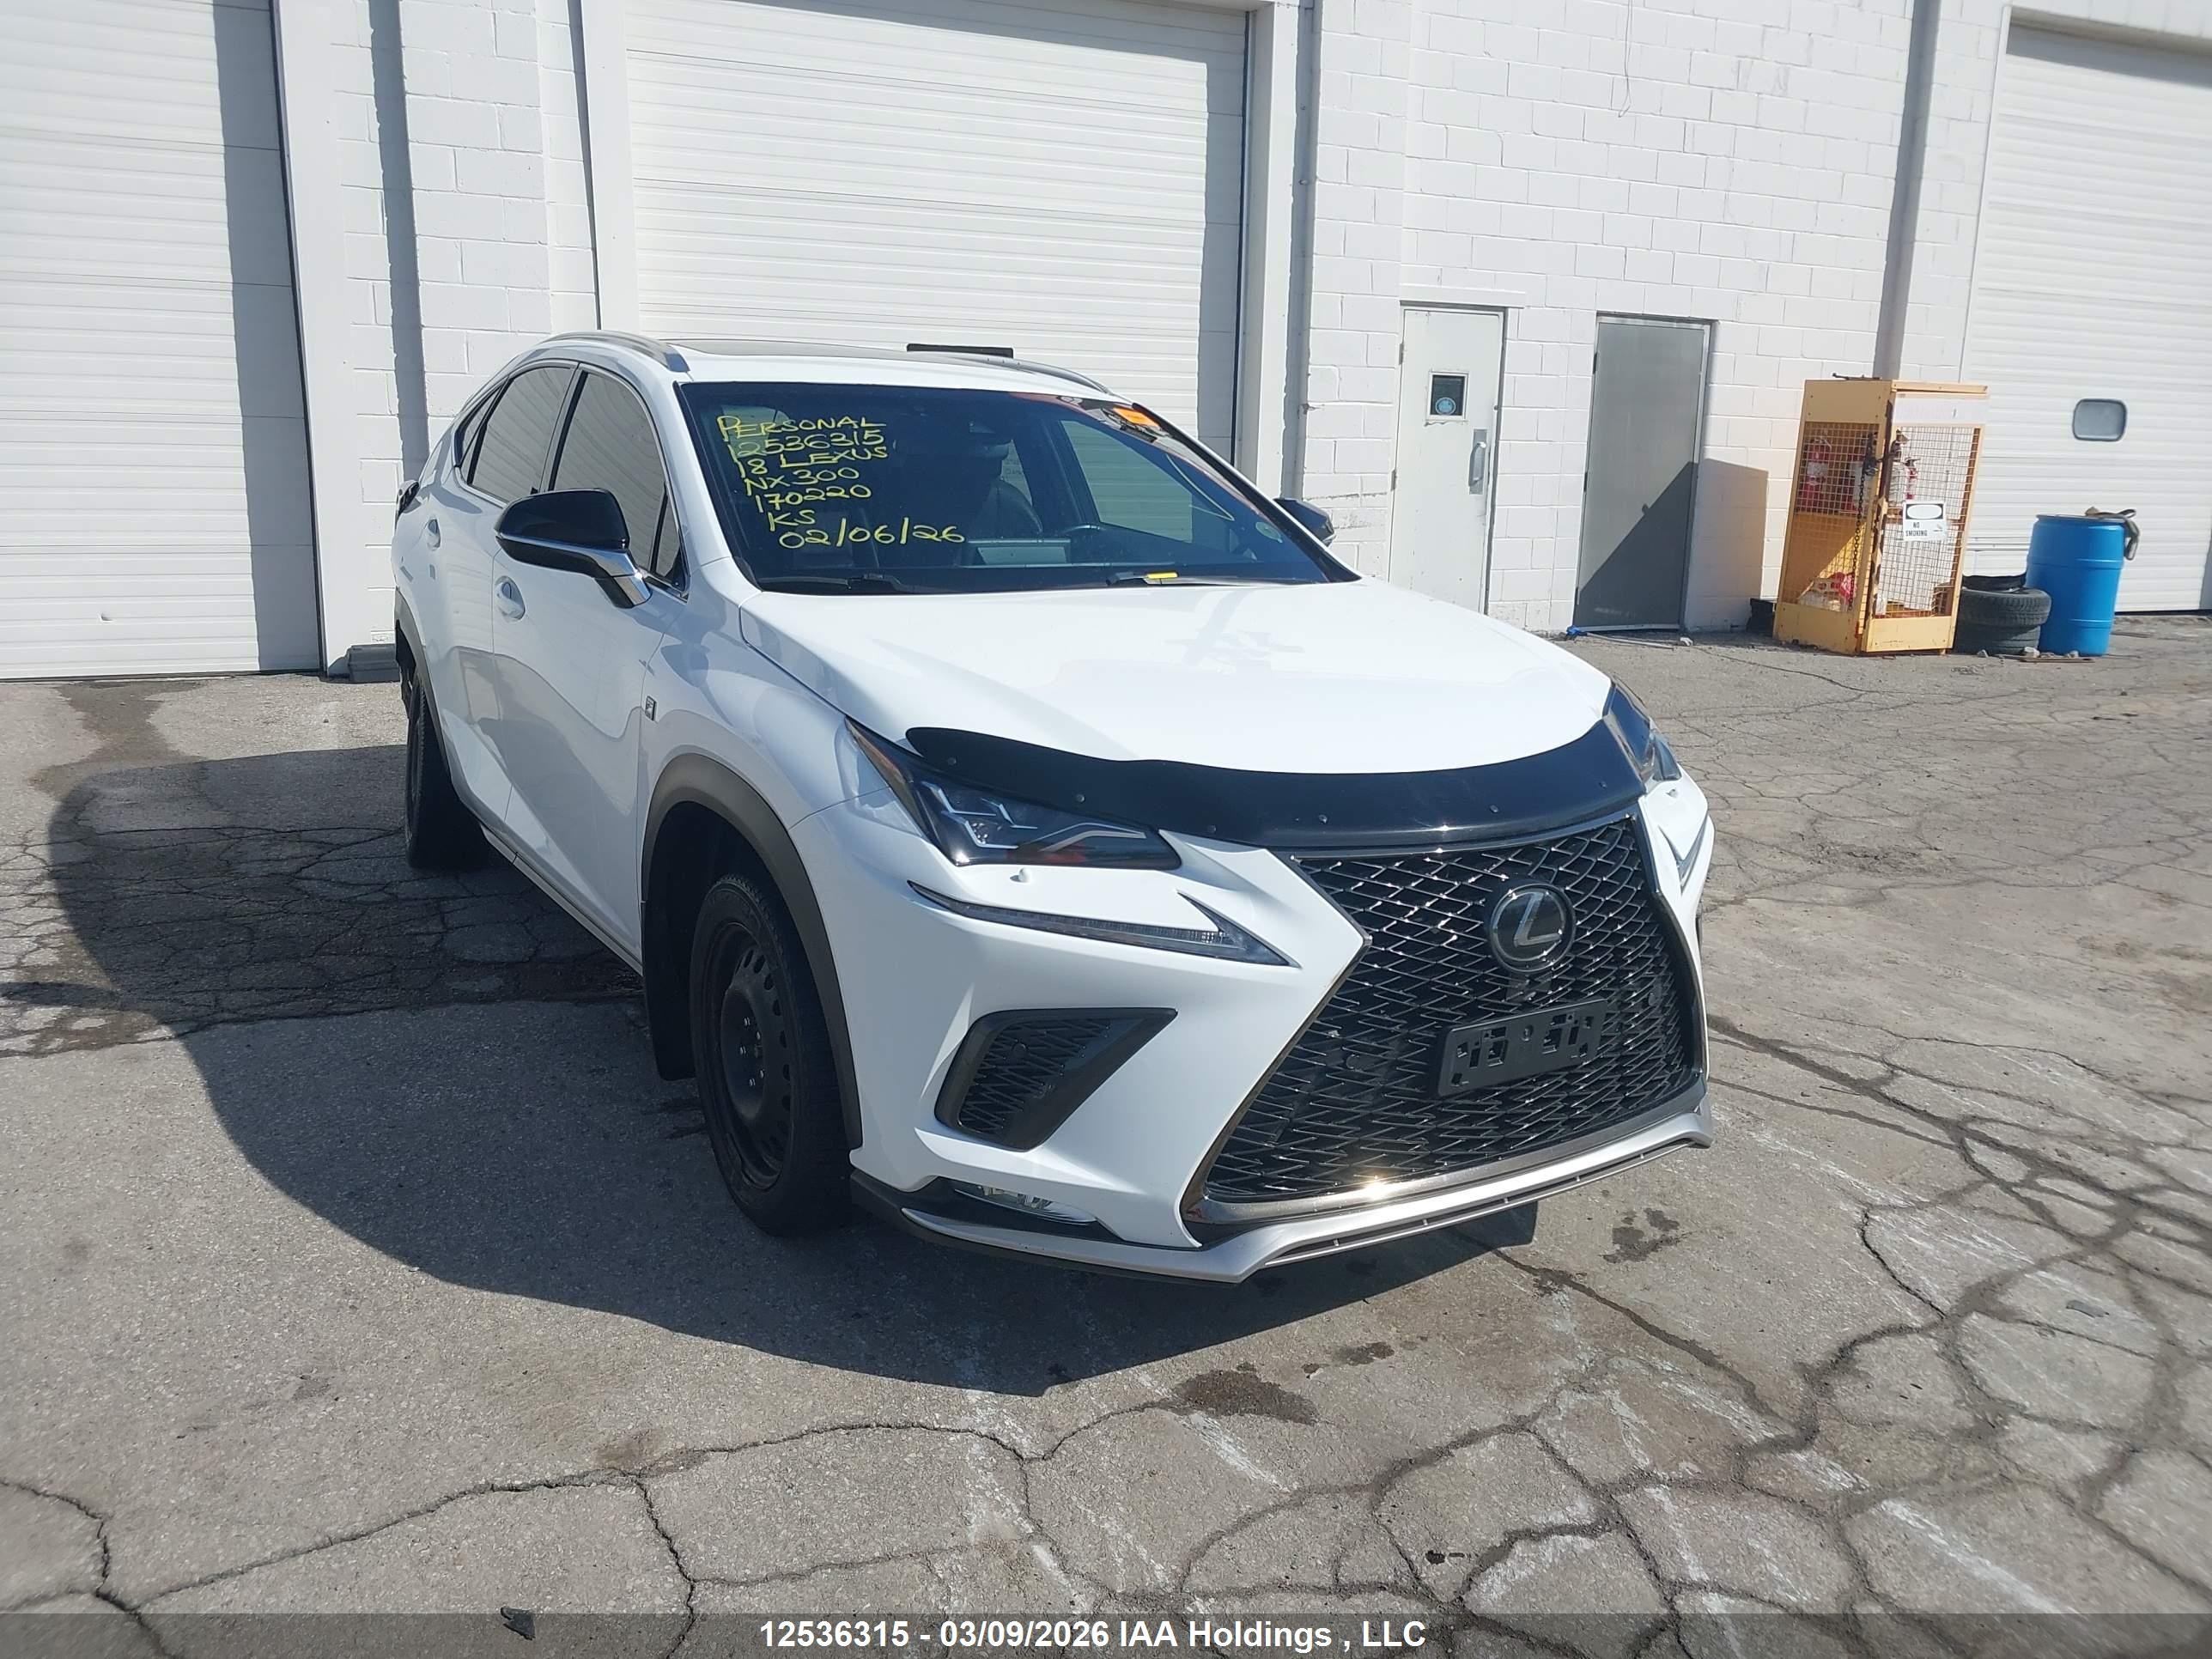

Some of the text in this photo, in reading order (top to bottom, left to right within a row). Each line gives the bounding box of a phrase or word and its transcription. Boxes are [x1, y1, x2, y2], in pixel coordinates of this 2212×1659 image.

[716, 415, 887, 442] PERSONAL
[727, 429, 885, 465] 12536315
[779, 446, 889, 468] LEXUS
[755, 483, 872, 514] 170220
[767, 509, 816, 532] KS
[778, 516, 966, 549] 02/06/26
